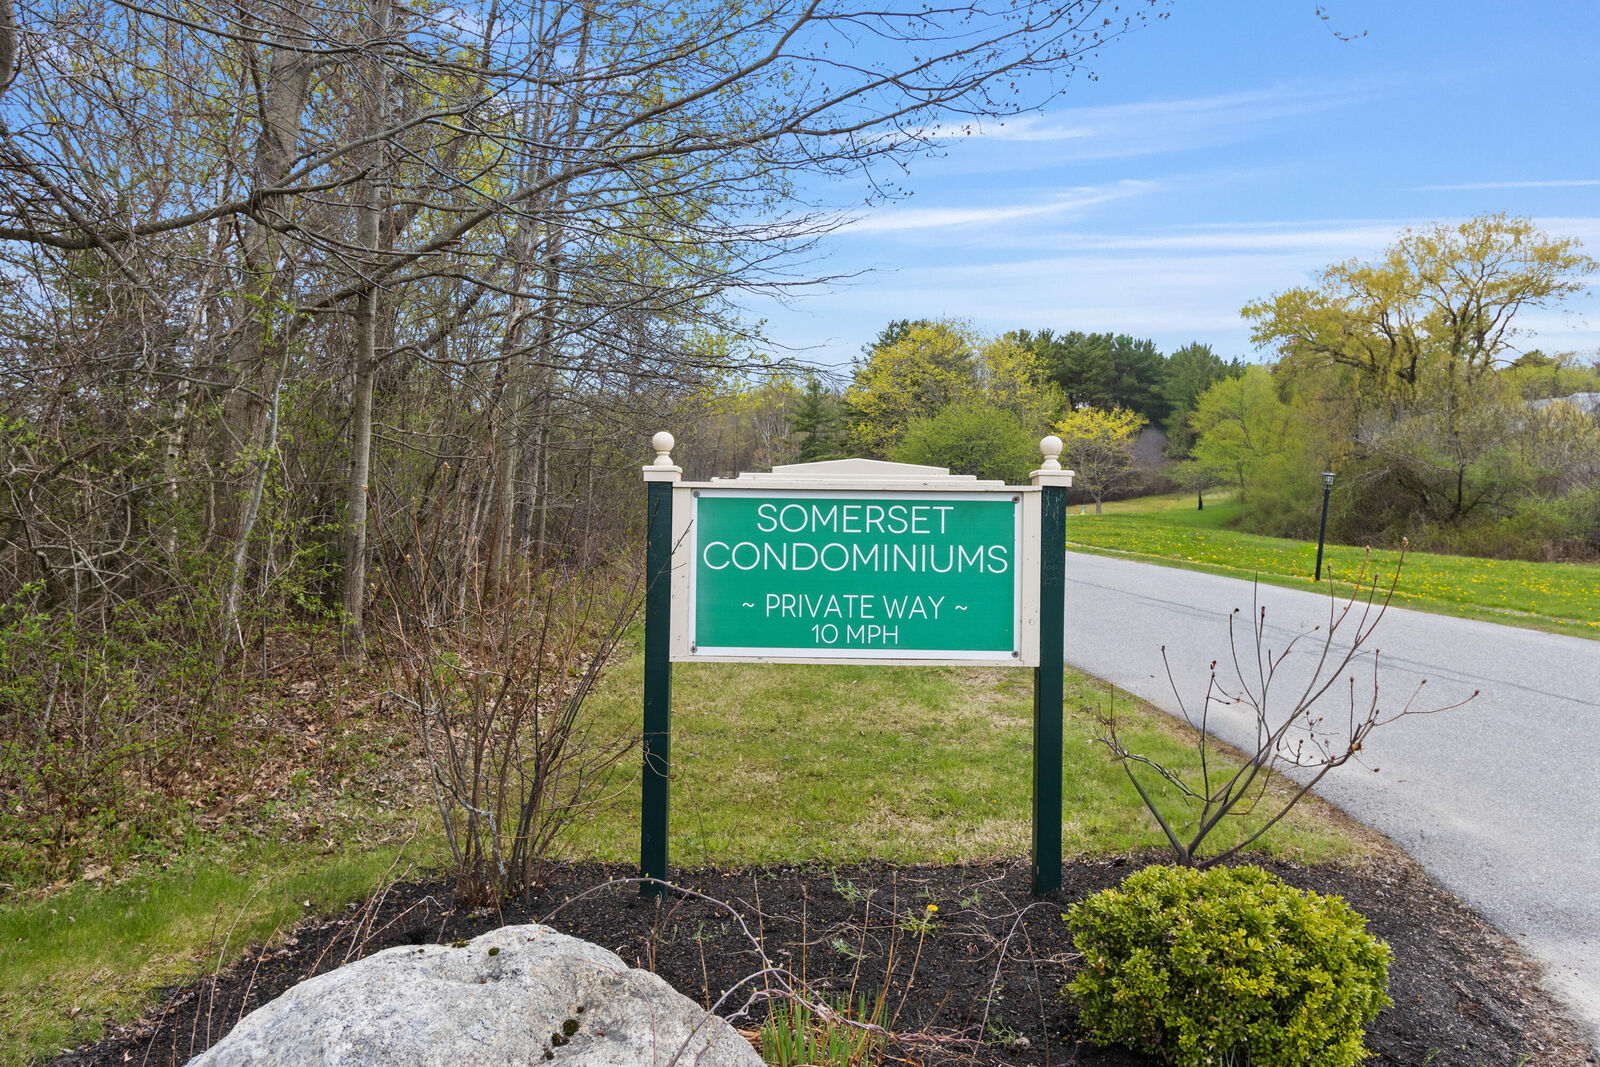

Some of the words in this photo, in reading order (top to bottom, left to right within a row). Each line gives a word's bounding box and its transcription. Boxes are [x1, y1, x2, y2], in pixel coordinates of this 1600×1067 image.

[756, 502, 956, 535] SOMERSET
[702, 540, 1009, 574] CONDOMINIUMS
[764, 592, 876, 620] PRIVATE
[881, 594, 946, 621] WAY
[810, 623, 840, 645] 10
[845, 623, 899, 646] MPH
